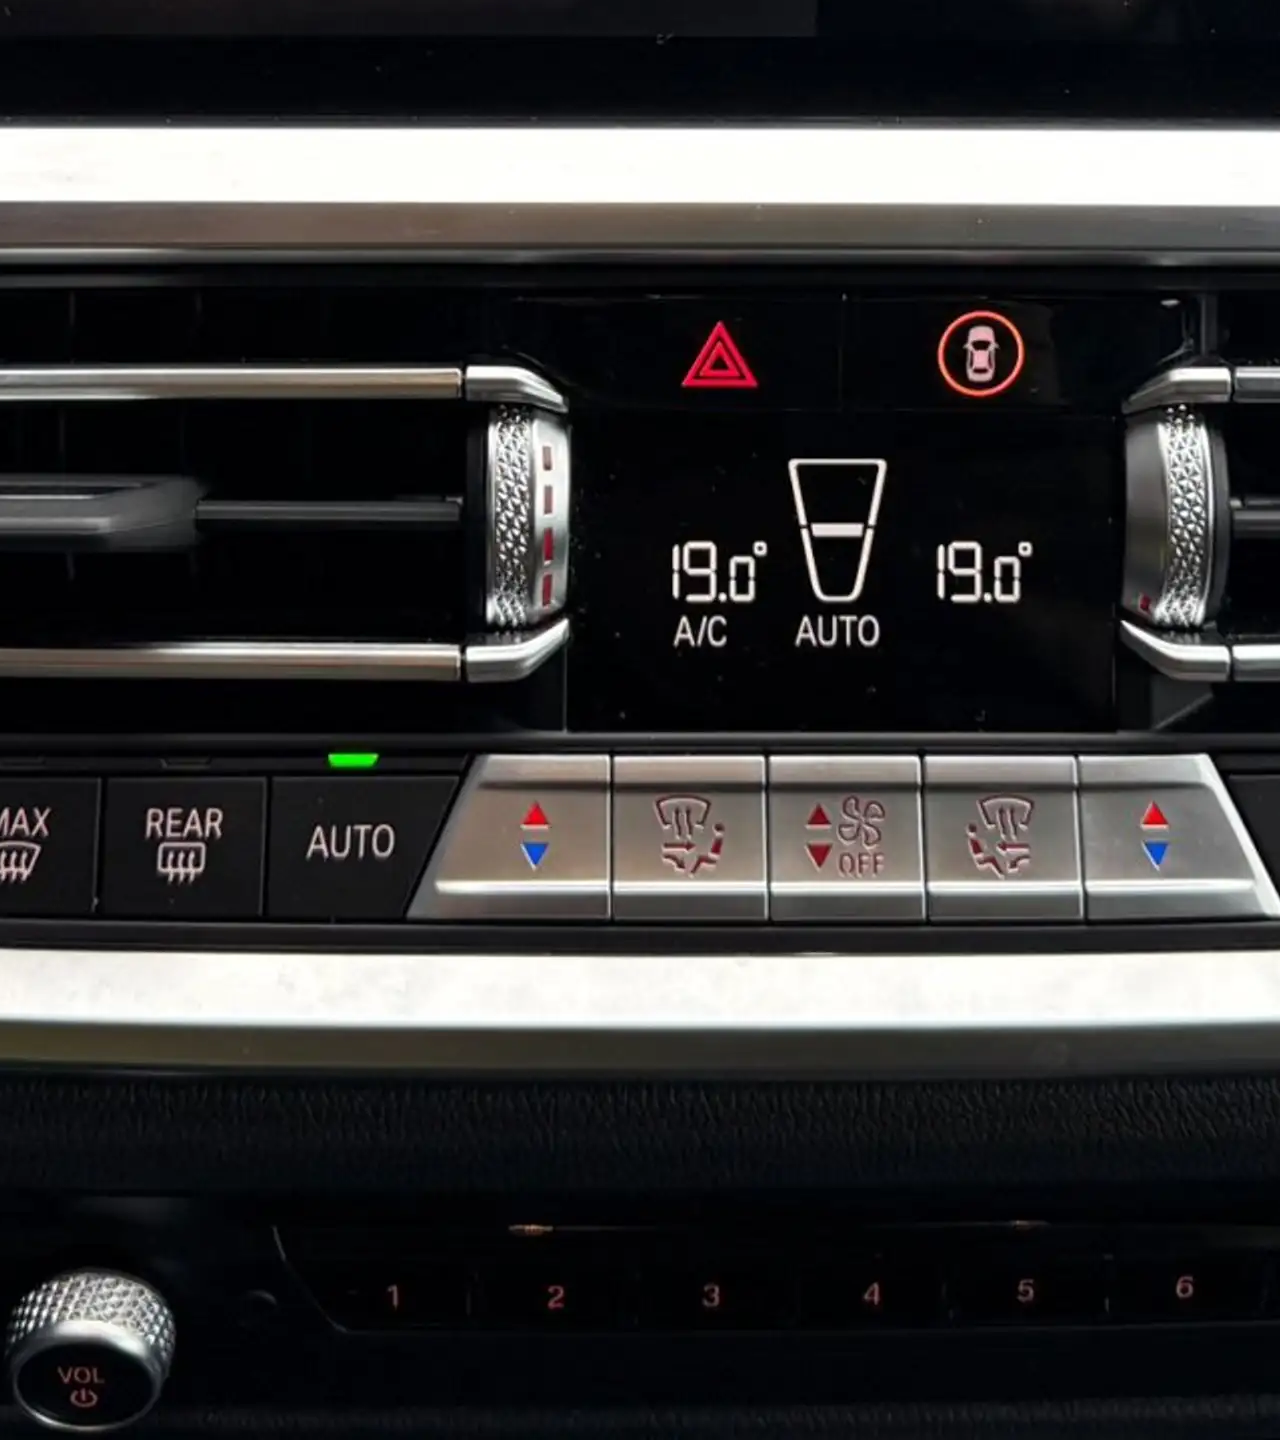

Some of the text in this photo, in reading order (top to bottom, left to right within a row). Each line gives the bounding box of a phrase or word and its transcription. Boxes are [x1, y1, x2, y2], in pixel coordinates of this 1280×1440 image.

[673, 615, 727, 647] A/C
[795, 614, 880, 647] AUTO
[146, 807, 223, 838] REAR
[306, 823, 395, 858] AUTO
[839, 852, 884, 876] OFF
[387, 1284, 399, 1308] 1
[547, 1285, 565, 1310] 2
[703, 1284, 721, 1307] 3
[863, 1282, 881, 1306] 4
[1017, 1278, 1035, 1303] 5
[1175, 1275, 1194, 1299] 6
[57, 1366, 105, 1386] VOL
